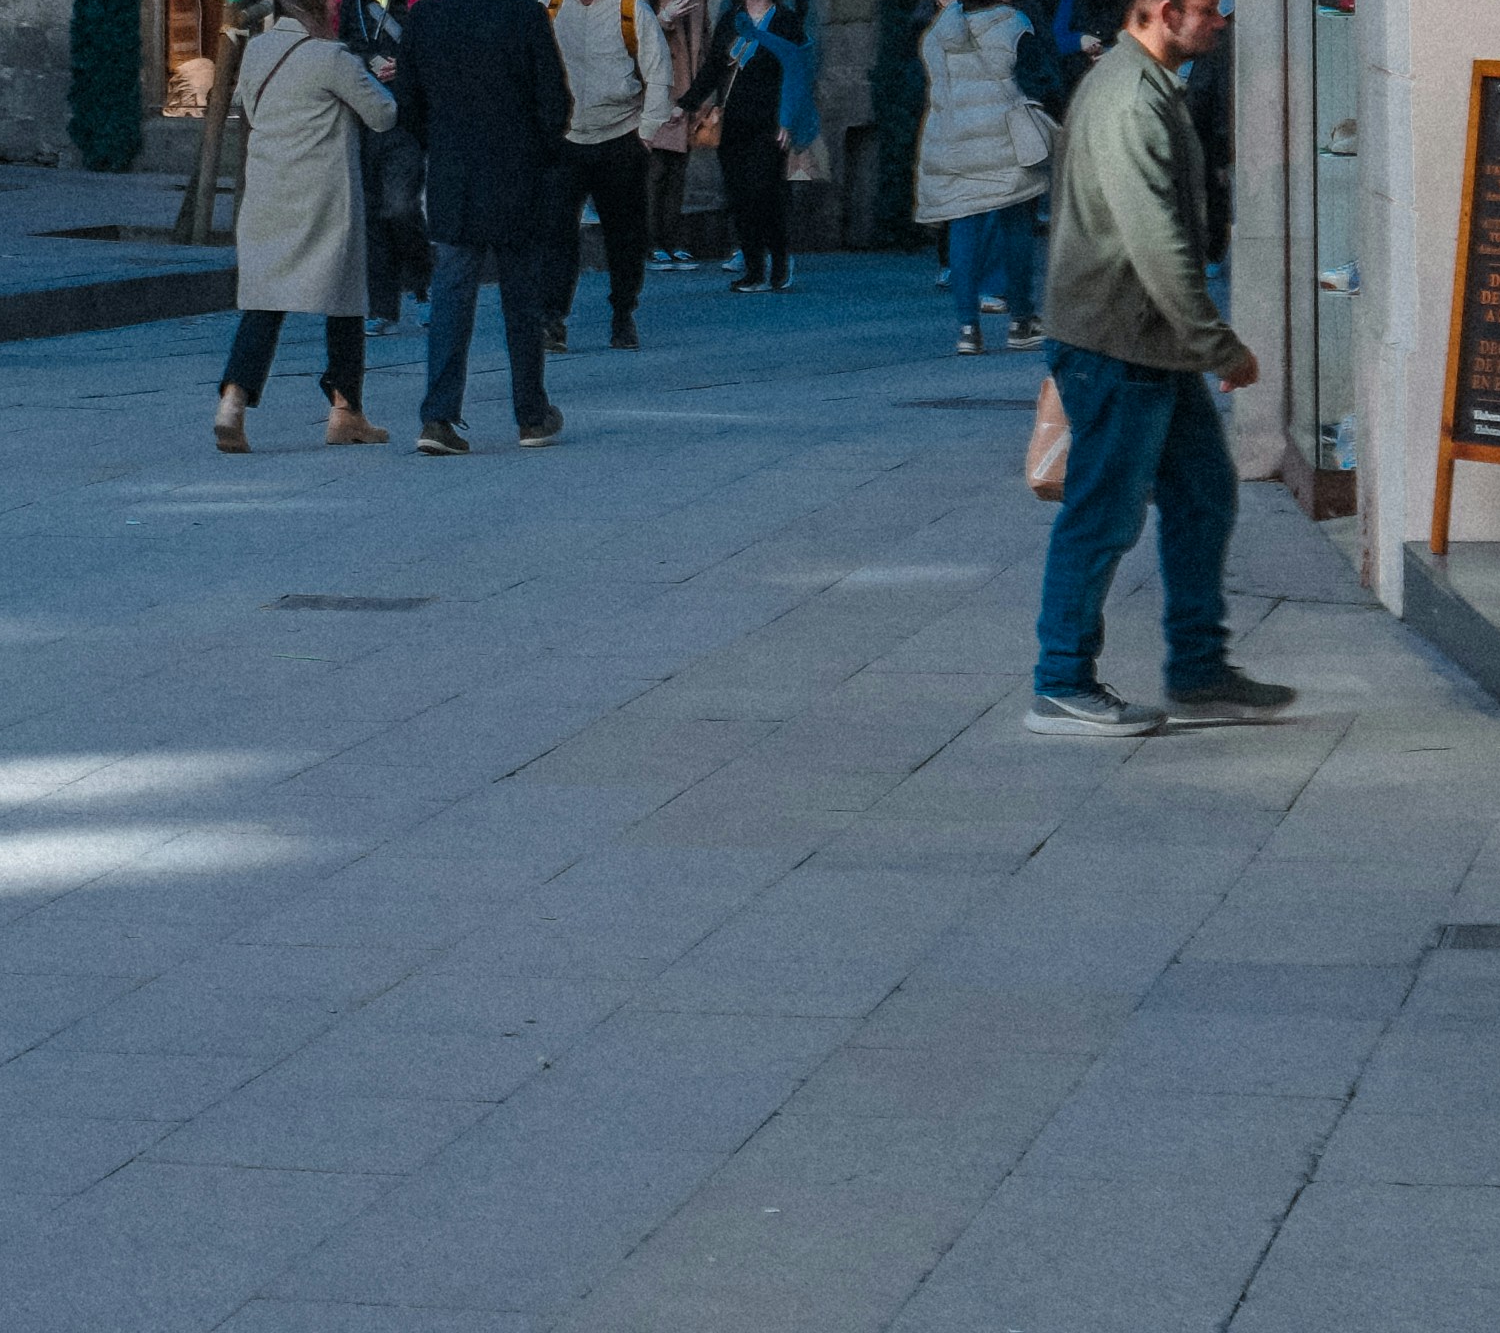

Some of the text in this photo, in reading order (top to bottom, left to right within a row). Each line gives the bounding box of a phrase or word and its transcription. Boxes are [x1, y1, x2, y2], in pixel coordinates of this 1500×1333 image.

[1481, 290, 1499, 305] DE
[1485, 309, 1496, 323] A
[1474, 357, 1494, 372] DE
